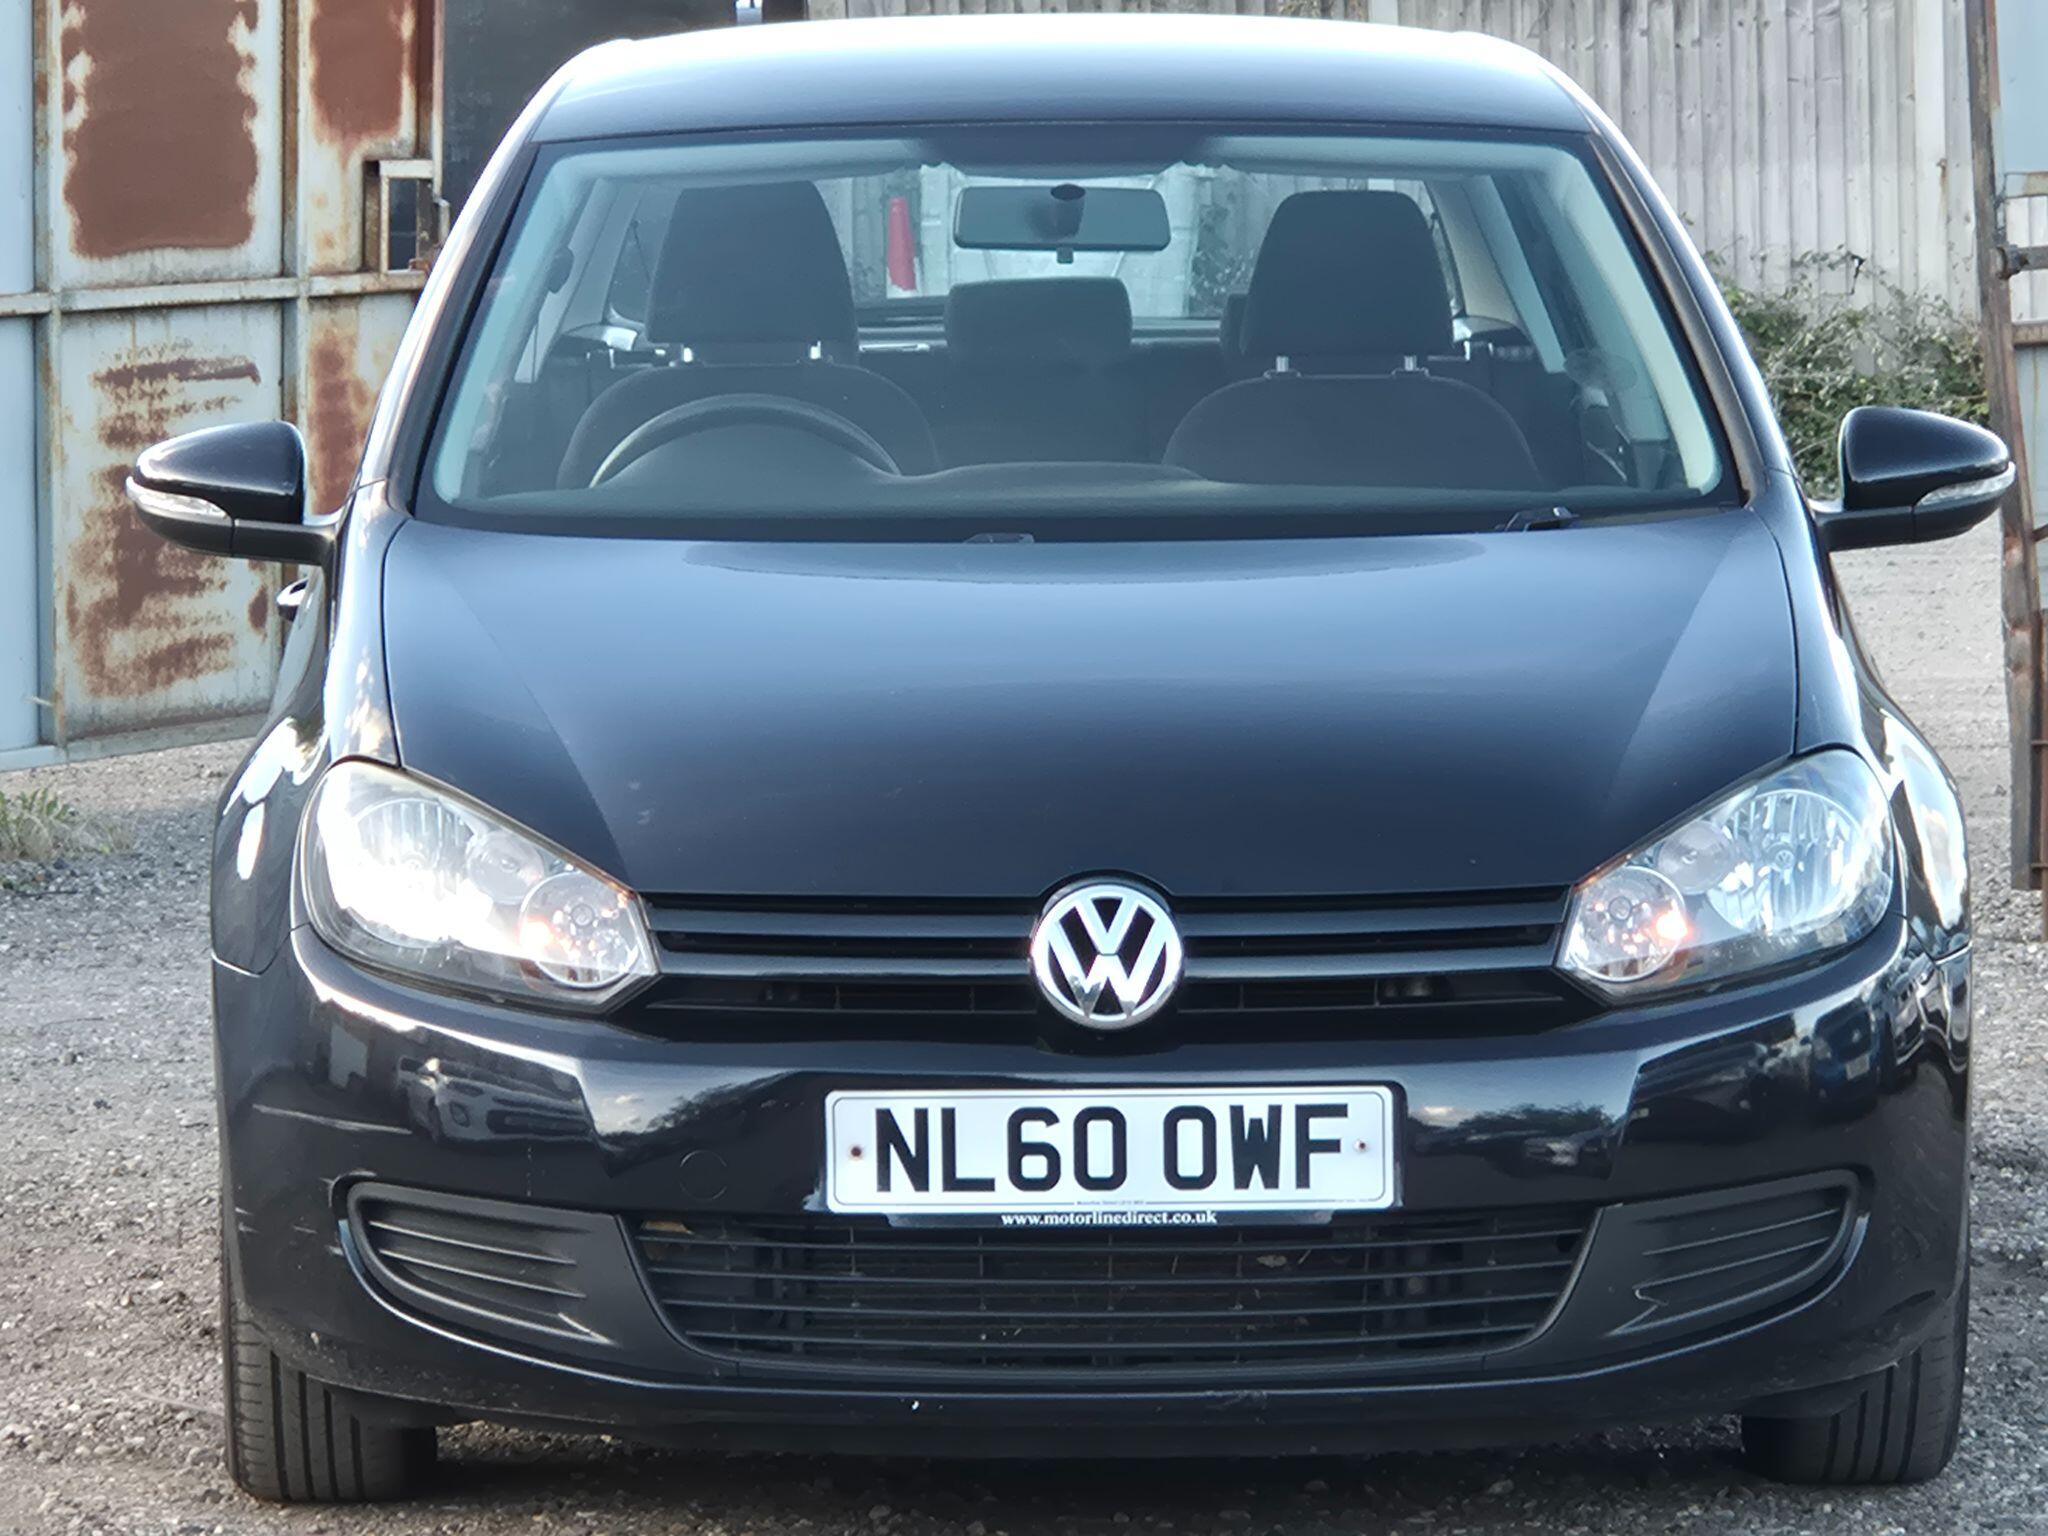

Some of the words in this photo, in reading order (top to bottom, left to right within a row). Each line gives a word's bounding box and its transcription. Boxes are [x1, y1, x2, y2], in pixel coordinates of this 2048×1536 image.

[876, 1106, 1127, 1192] NL60
[1163, 1103, 1349, 1191] OWF
[1001, 1210, 1217, 1226] www.motorlinedirect.co.uk
